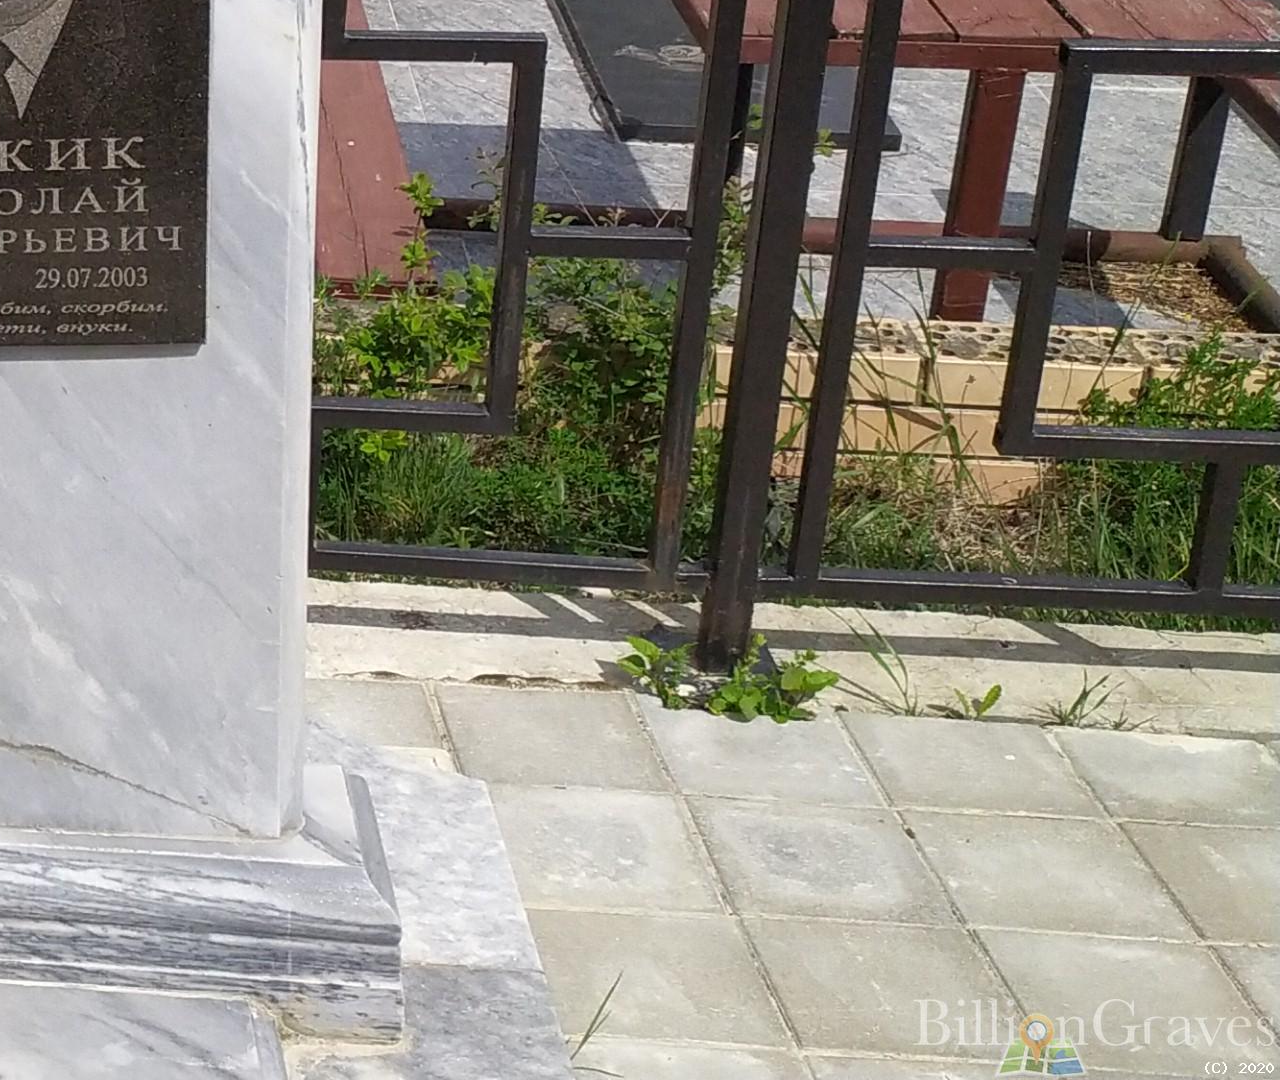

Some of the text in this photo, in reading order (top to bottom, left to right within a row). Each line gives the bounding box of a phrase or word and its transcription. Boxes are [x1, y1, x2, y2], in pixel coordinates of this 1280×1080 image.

[35, 266, 149, 290] 29.07.2003
[60, 299, 169, 316] скорбим.
[56, 322, 134, 336] внуки.
